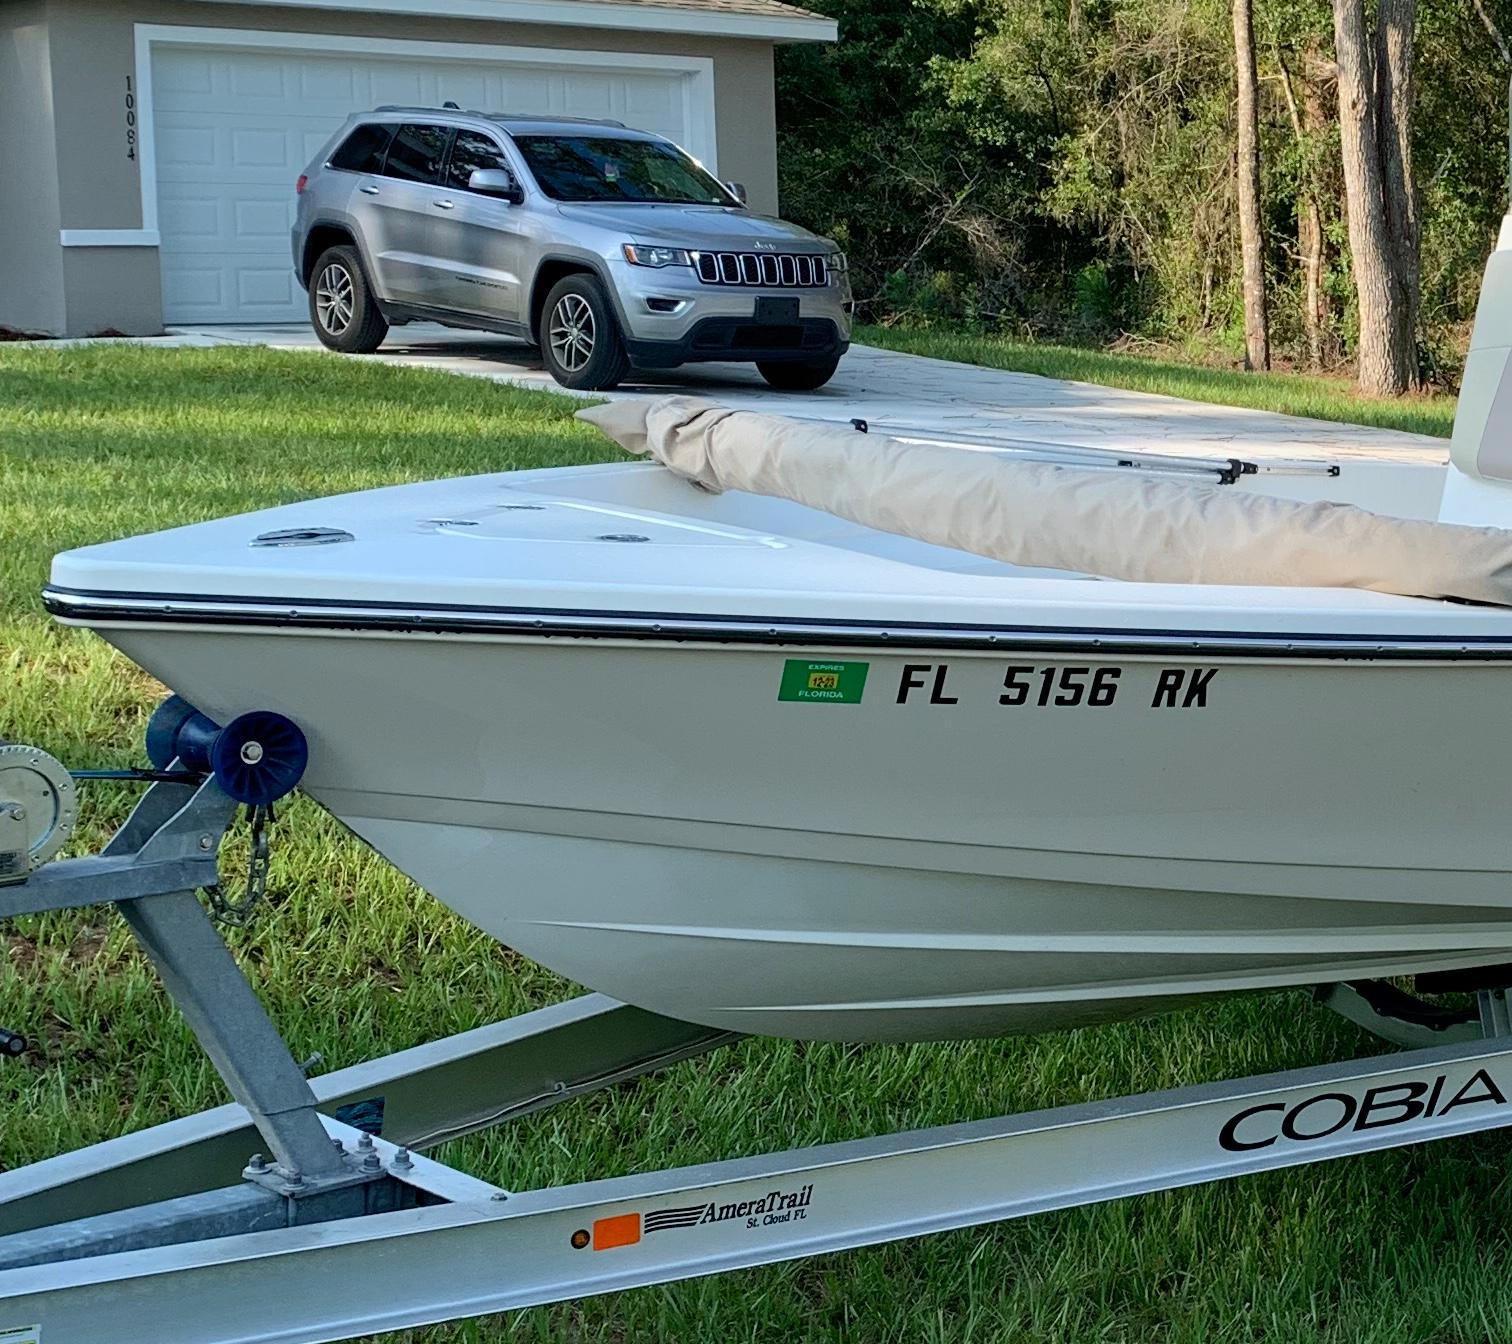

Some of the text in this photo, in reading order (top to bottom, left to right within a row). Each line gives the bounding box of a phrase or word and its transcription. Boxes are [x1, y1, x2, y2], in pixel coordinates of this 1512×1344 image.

[126, 75, 135, 161] 10084
[798, 689, 844, 699] FLORIDA
[896, 664, 1220, 708] FL 5156 RK
[1218, 1068, 1508, 1152] COBIA
[699, 1184, 814, 1224] AmeraTrail
[746, 1208, 807, 1229] St. Cloud FL
